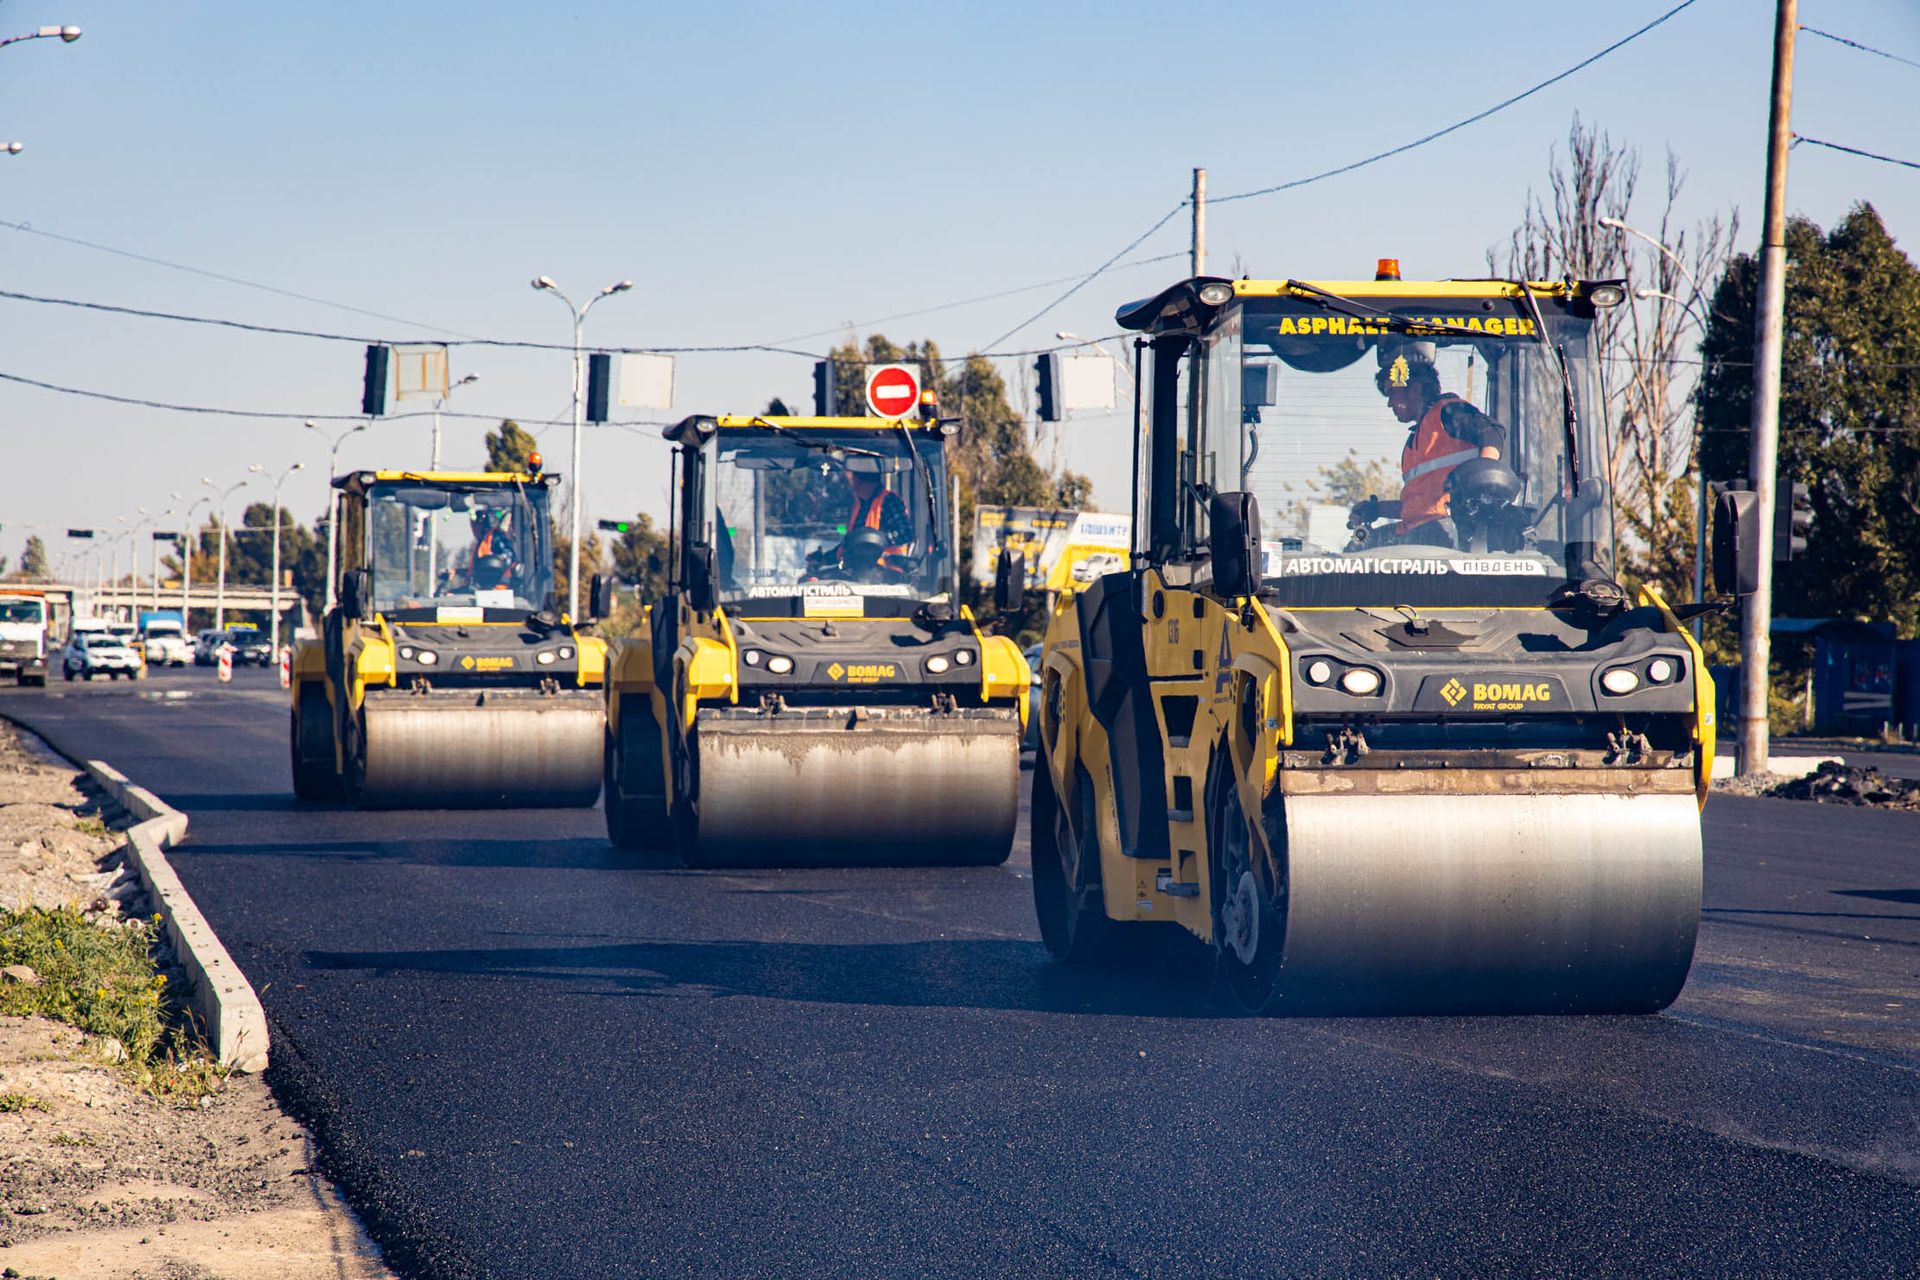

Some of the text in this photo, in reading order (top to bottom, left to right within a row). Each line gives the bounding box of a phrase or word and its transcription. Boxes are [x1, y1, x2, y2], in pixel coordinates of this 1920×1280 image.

[1279, 317, 1390, 335] ASPHALT
[1285, 558, 1535, 575] АВТОМАГІСТРАЛЬ ПІВДЕНЬ
[847, 665, 896, 678] BOMAG
[1473, 683, 1551, 702] BOMAG
